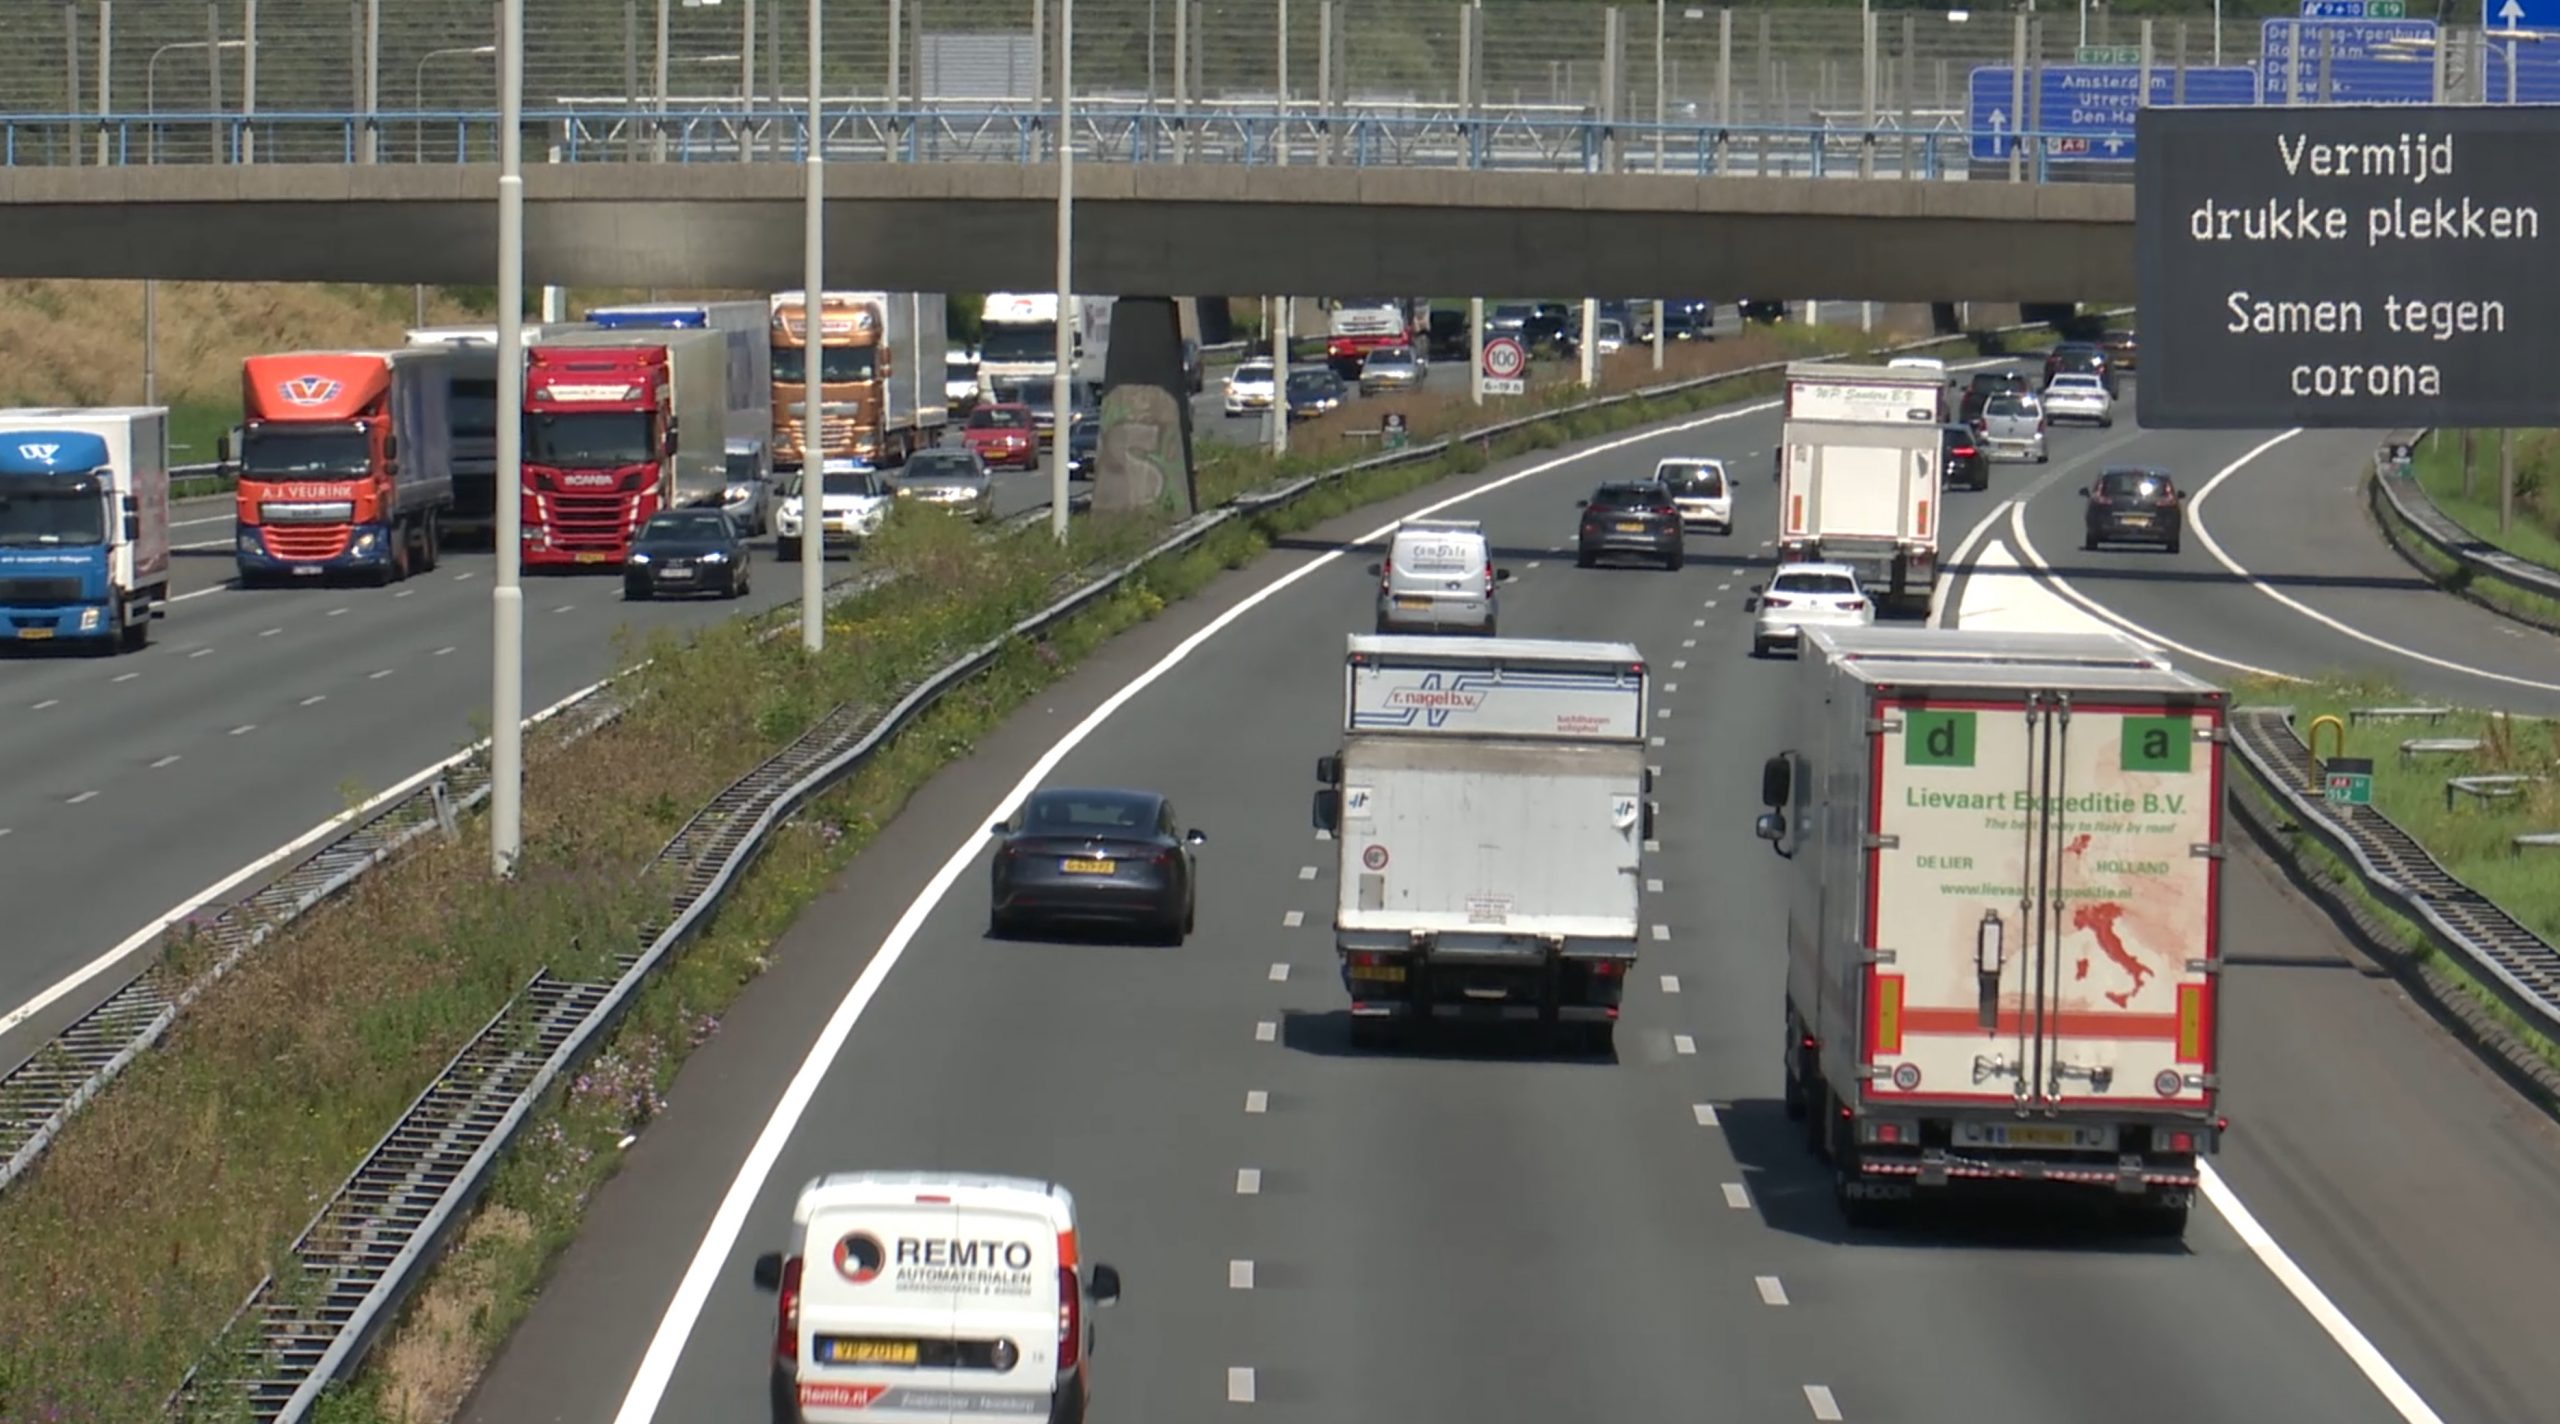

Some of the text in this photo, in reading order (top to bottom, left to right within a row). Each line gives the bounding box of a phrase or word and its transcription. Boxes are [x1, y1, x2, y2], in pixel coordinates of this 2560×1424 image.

[2061, 75, 2166, 89] Amsterdm
[2071, 109, 2105, 124] Den
[2278, 133, 2453, 184] Vermijd
[2191, 196, 2539, 247] drukke plekken
[2227, 291, 2505, 340] Samen tegen
[1491, 351, 1517, 366] 100
[2291, 364, 2441, 396] corona
[563, 475, 613, 486] SCANIA
[289, 486, 353, 497] VEURINK
[1405, 690, 1449, 707] nagel
[1450, 692, 1476, 706] b.v.
[1926, 718, 1954, 757] d
[2143, 727, 2168, 759] a
[1906, 786, 2187, 815] Lievaart Expeditie B.V.
[1984, 817, 2009, 830] The
[2078, 821, 2092, 832] to
[2127, 822, 2142, 835] by
[1916, 855, 1973, 870] DE LIER
[2096, 860, 2170, 875] HOLLAND
[896, 1237, 1033, 1270] REMTO
[896, 1267, 1032, 1285] AUTOMATERIALEN
[800, 1384, 869, 1406] Remto.nl
